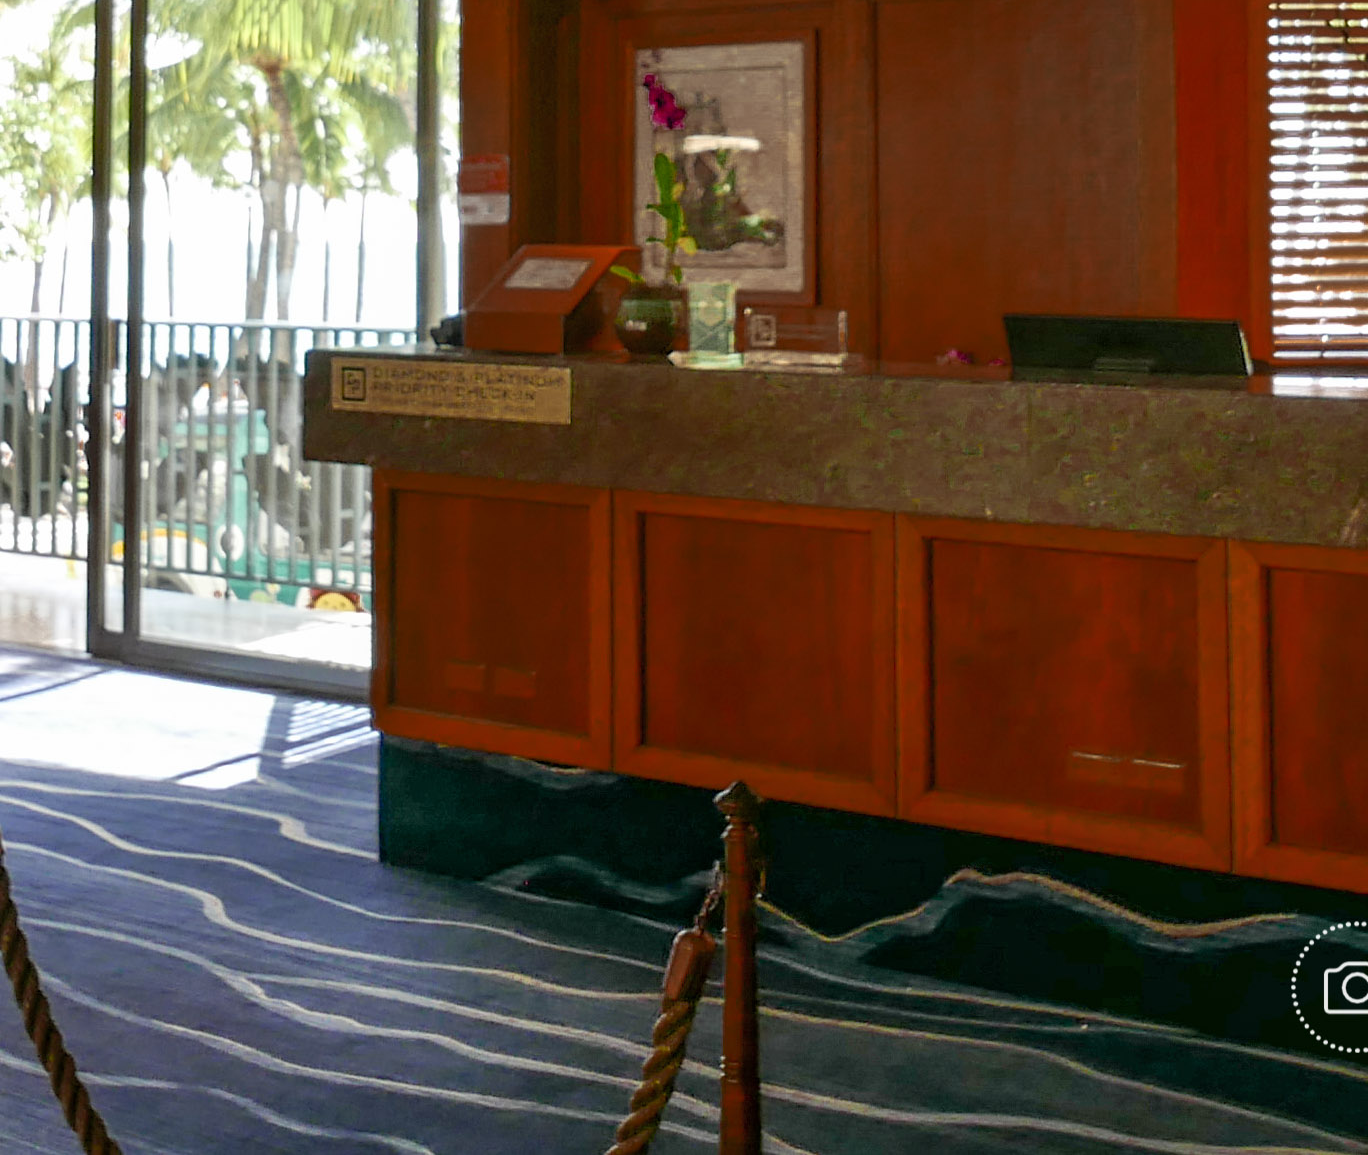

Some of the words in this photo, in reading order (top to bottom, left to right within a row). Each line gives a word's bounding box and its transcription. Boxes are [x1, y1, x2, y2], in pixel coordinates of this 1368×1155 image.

[373, 367, 450, 382] DIAMOND
[473, 372, 565, 388] PLATINUM
[372, 381, 448, 396] PRIORITY
